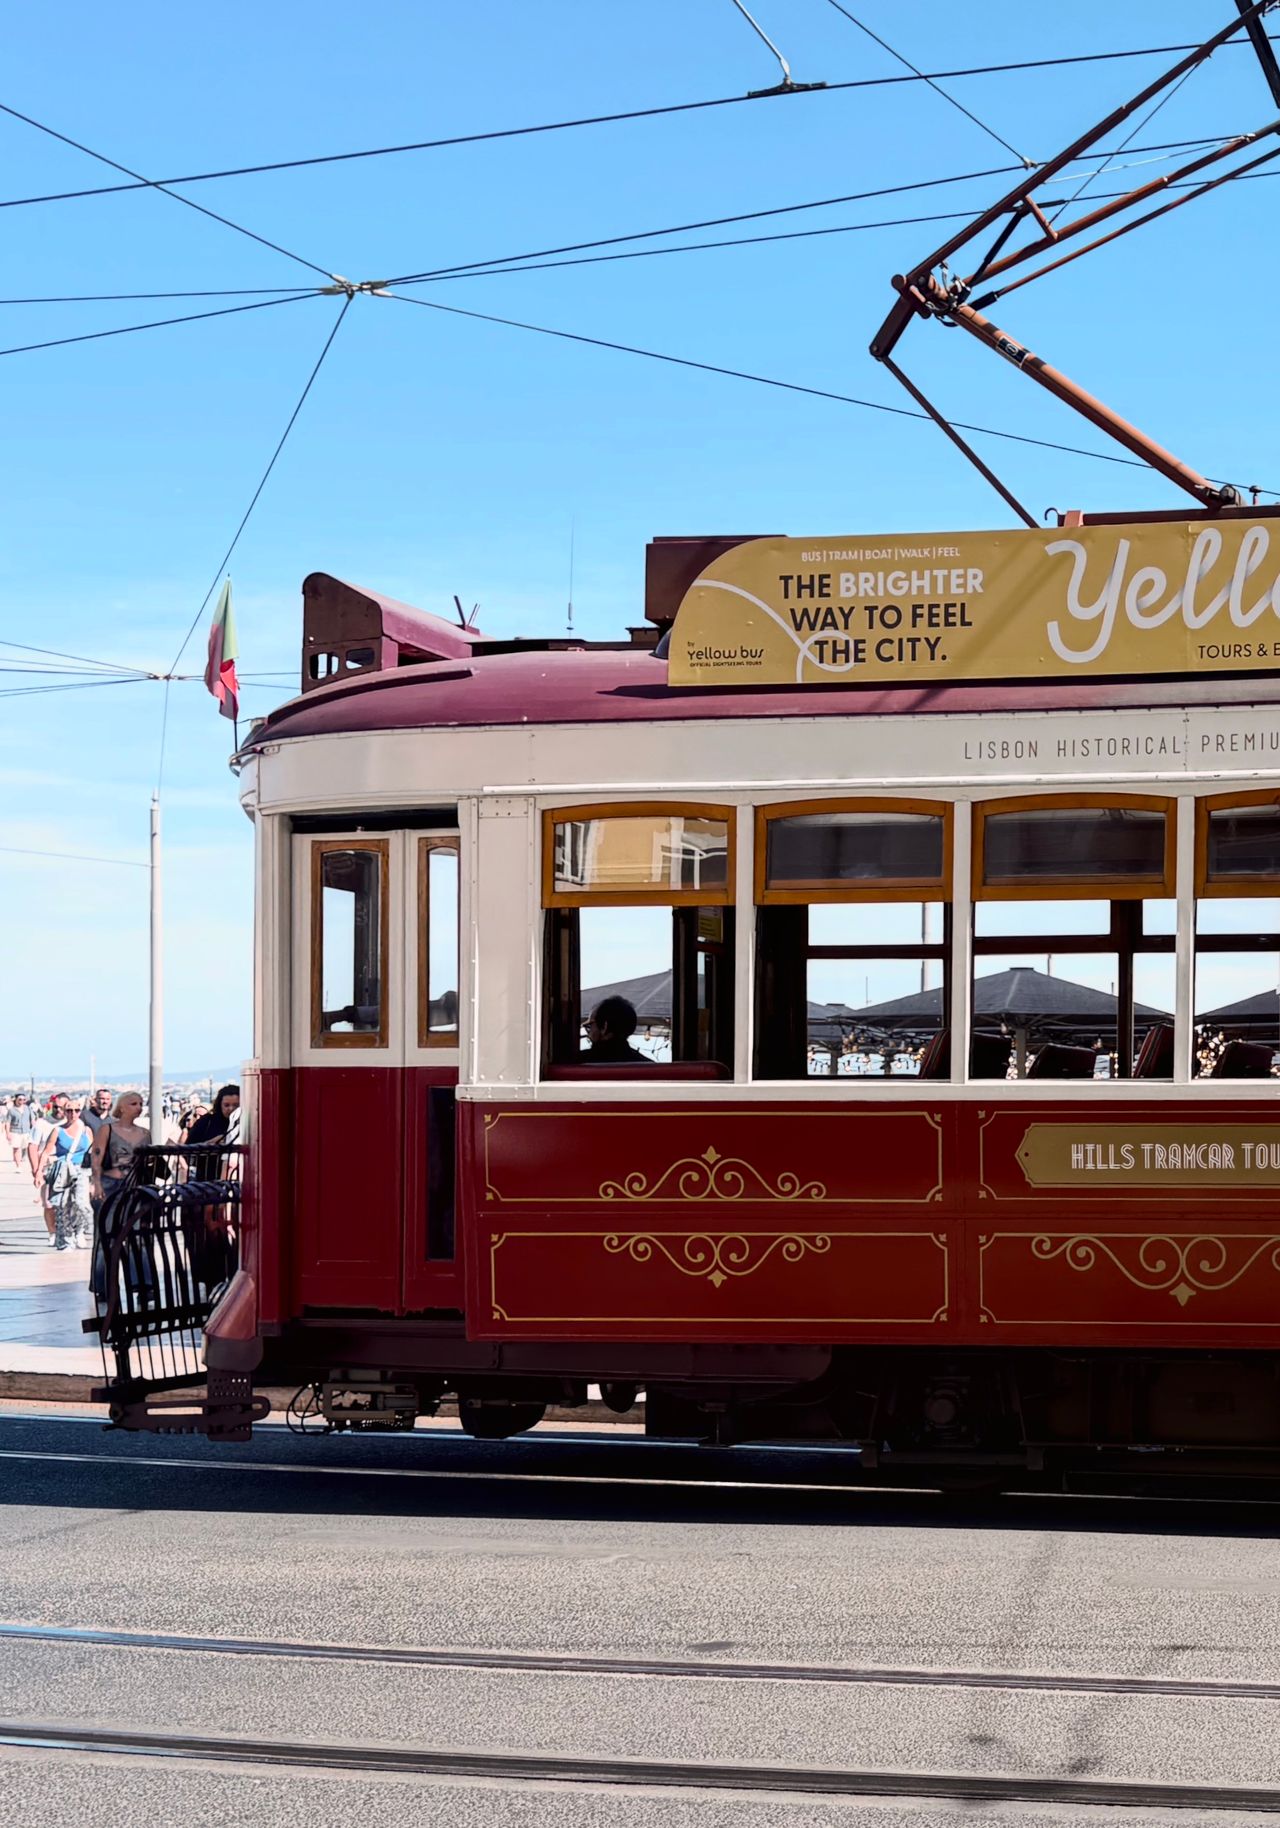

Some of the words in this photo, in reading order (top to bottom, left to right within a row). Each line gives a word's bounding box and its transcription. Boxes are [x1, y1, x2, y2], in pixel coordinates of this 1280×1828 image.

[802, 552, 821, 562] BUS
[829, 551, 858, 560] TRAM
[865, 550, 893, 560] BOAT
[900, 548, 930, 558] WALK
[938, 548, 960, 557] FEEL
[779, 574, 831, 599] THE
[840, 568, 984, 598] BRIGHTER
[790, 606, 855, 631] WAY
[864, 605, 902, 629] TO
[912, 603, 972, 628] FEEL
[814, 639, 866, 664] THE
[875, 637, 947, 662] CITY.
[1198, 644, 1252, 658] TOURS
[1257, 643, 1267, 656] &
[965, 741, 1038, 760] LISBON
[1058, 736, 1180, 758] HISTORICAL
[1072, 1144, 1135, 1170] HILLS
[1141, 1144, 1235, 1169] TRAMCAR
